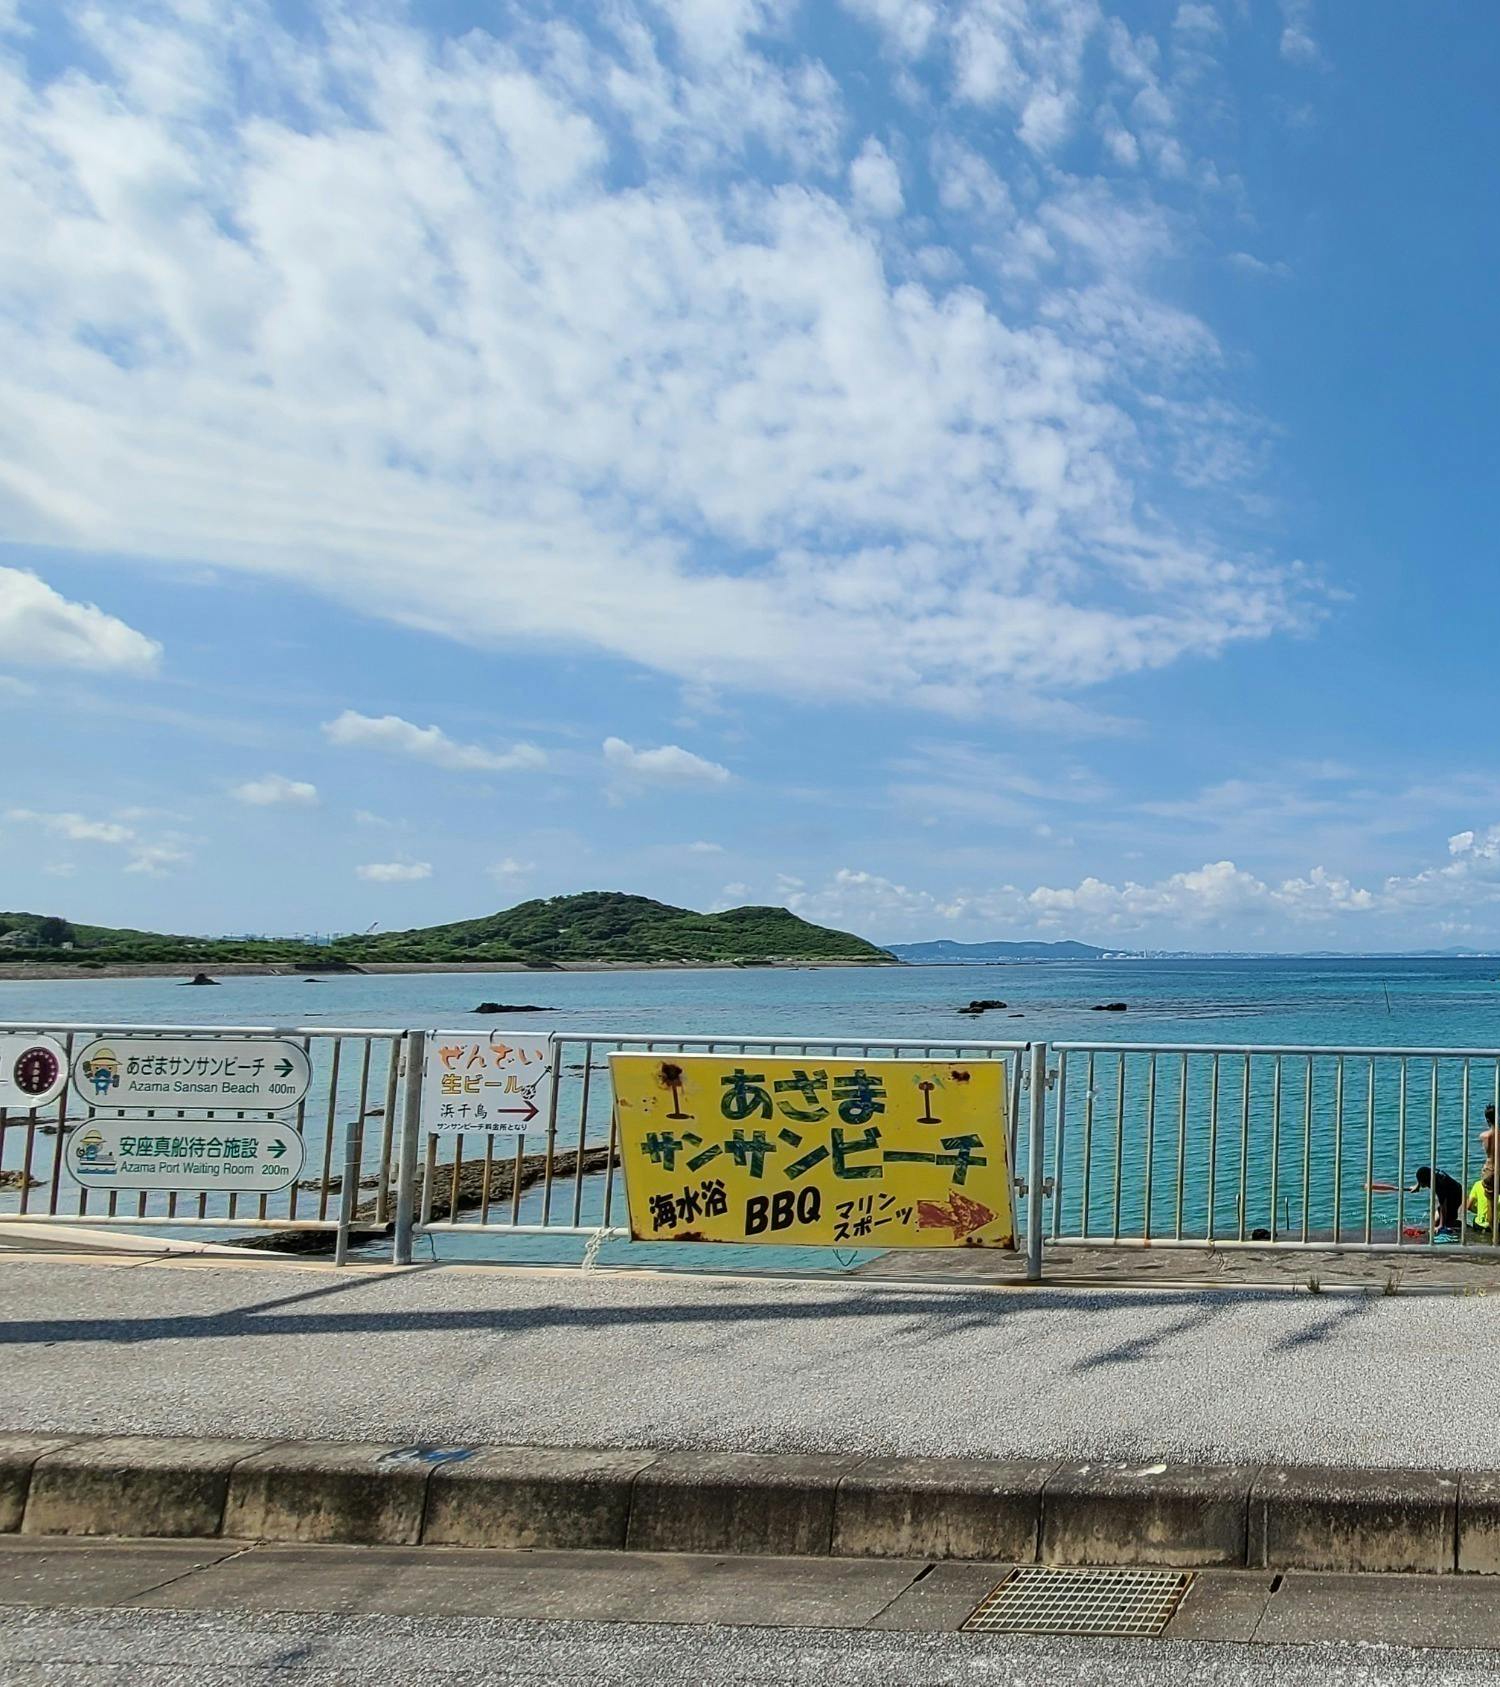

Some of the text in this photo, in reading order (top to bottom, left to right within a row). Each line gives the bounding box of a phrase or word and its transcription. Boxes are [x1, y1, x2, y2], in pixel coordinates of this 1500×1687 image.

[126, 1055, 265, 1078] あざまサンサンビーチ
[128, 1080, 296, 1094] Azama Sansan Beach 400m
[441, 1074, 523, 1095] 生ビール
[720, 1068, 888, 1124] あざま
[440, 1103, 488, 1119] 浜千鳥
[119, 1136, 258, 1158] 安座真船待合施設
[641, 1126, 987, 1185] サンサンビーチ
[120, 1162, 289, 1176] Azama Port Waiting Room 200m
[649, 1178, 729, 1232] 海水浴
[745, 1185, 821, 1235] BBQ
[834, 1192, 897, 1221] マリン
[833, 1208, 913, 1242] スポーツ
